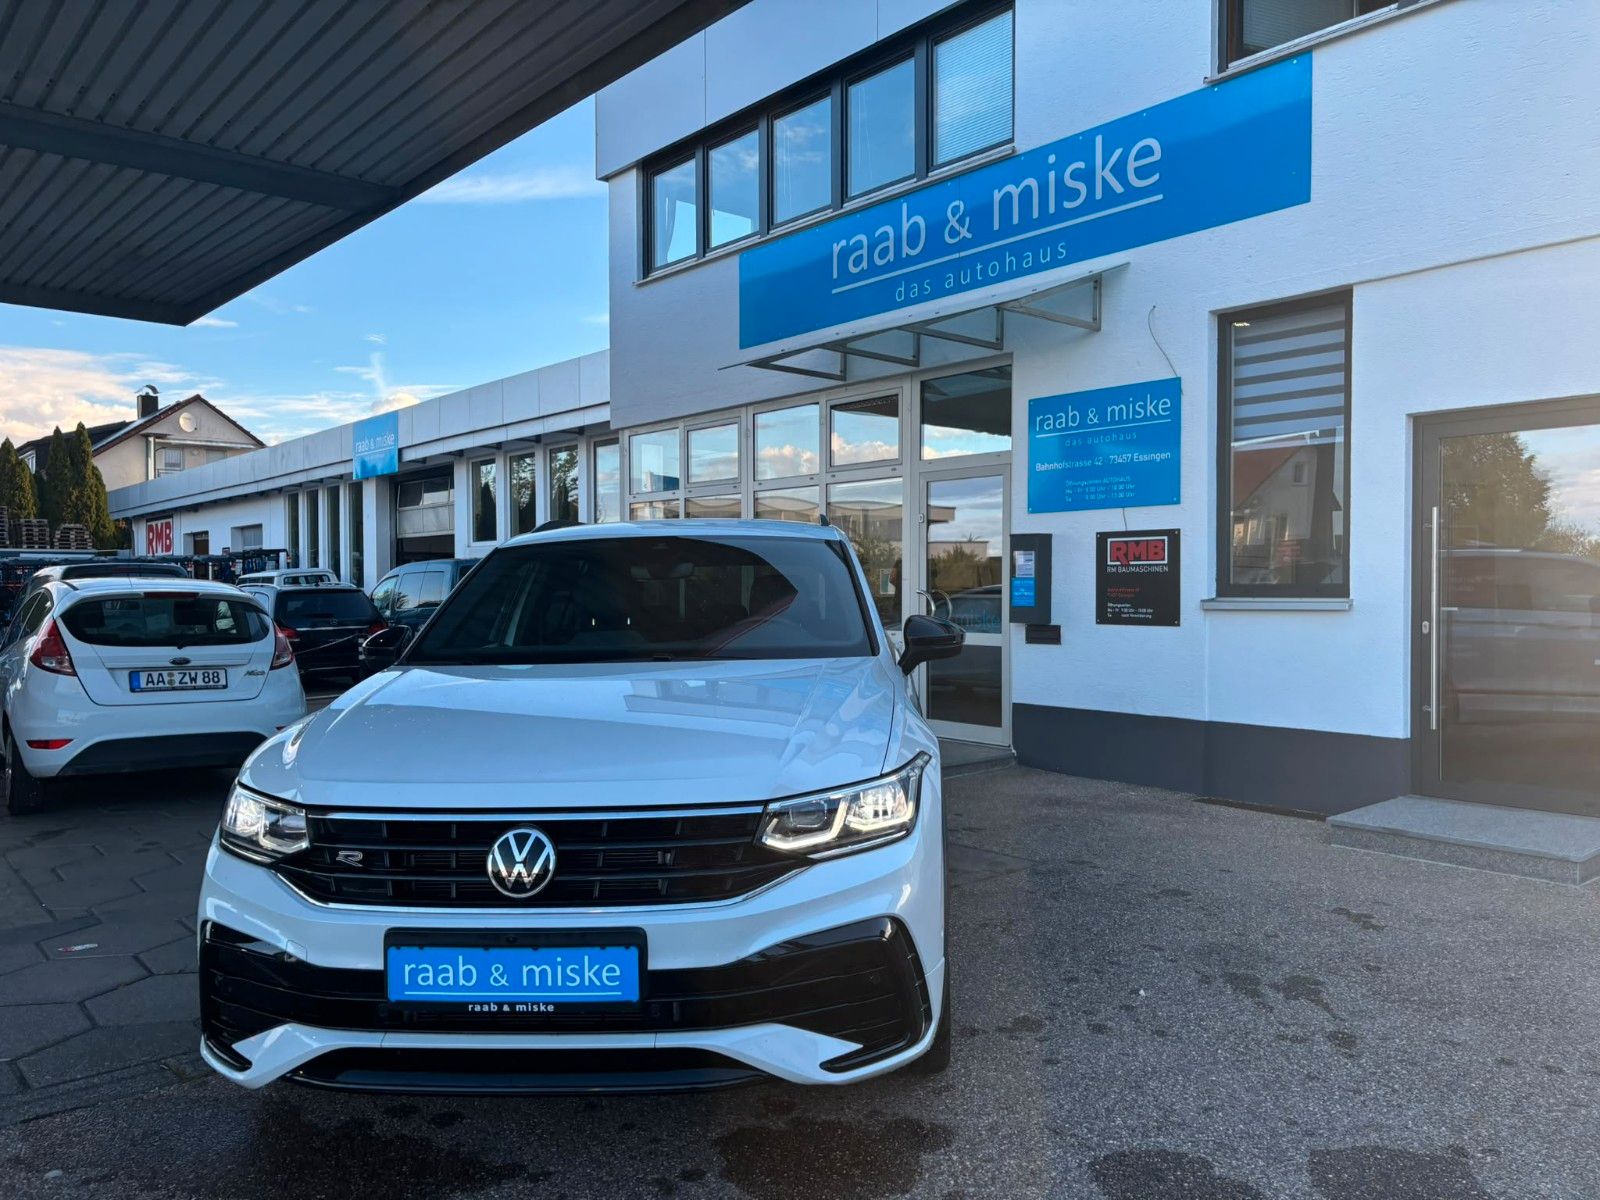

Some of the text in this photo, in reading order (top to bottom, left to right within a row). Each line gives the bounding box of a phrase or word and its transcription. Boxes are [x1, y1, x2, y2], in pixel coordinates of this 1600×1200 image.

[832, 134, 1162, 280] raab & miske
[895, 241, 1067, 302] das autohaus
[1036, 393, 1171, 432] raab & miske
[1064, 432, 1137, 448] das autohaus
[1094, 457, 1104, 466] 42
[1133, 451, 1171, 463] Essingen
[147, 521, 172, 556] RMB
[1110, 540, 1165, 565] RMB
[1117, 564, 1169, 573] BAUMASCHINEN
[145, 671, 221, 687] AA ZW 88
[404, 955, 621, 986] raab & miske
[468, 1002, 498, 1012] raab
[516, 1002, 554, 1012] miske
